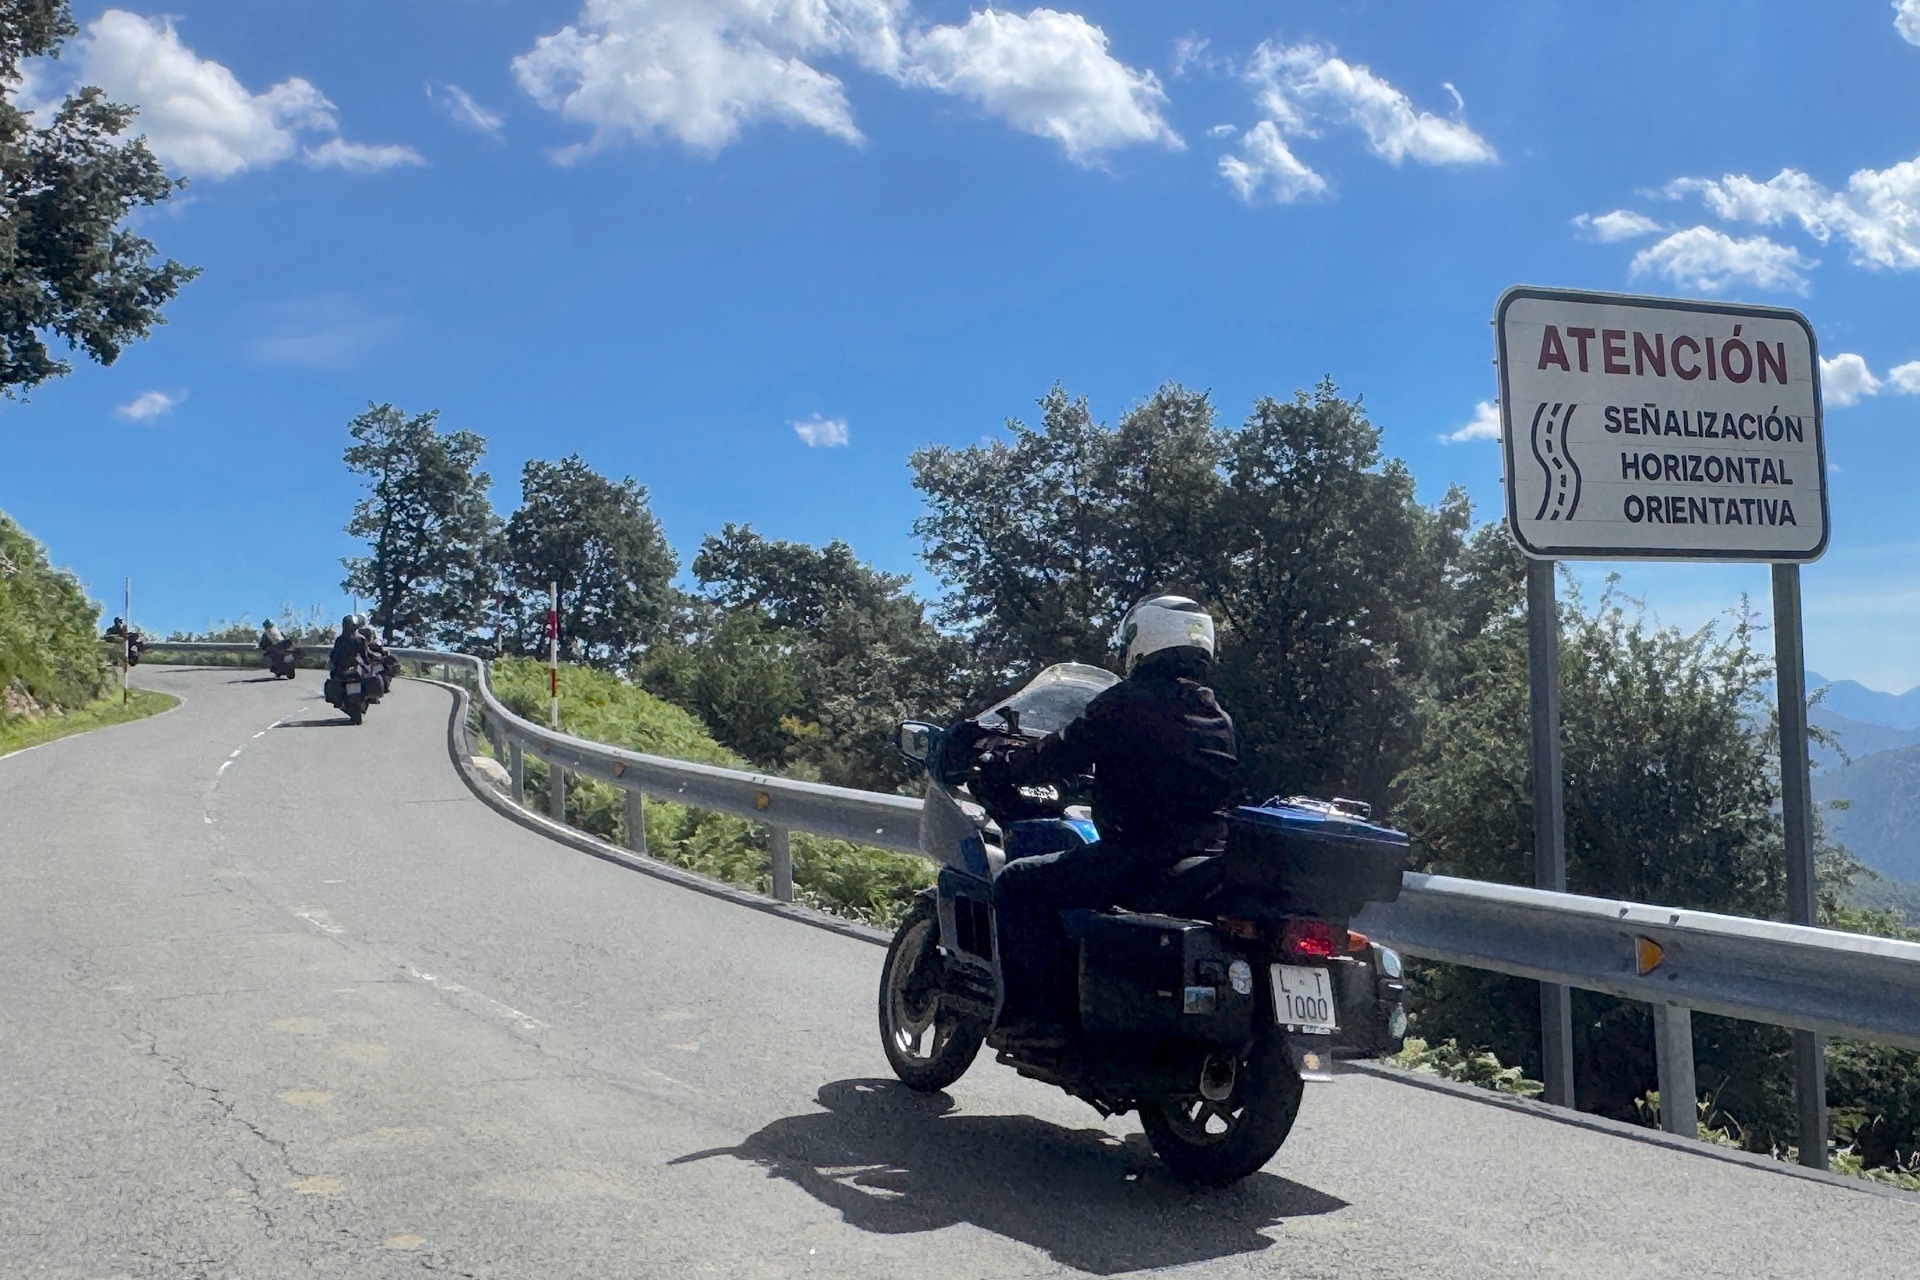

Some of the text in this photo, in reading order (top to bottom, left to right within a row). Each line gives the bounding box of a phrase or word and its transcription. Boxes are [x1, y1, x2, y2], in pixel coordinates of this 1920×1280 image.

[1537, 323, 1788, 385] ATENCIÓN
[1604, 402, 1804, 443] SEÑALIZACIÓN
[1621, 451, 1794, 485] HORIZONTAL
[1623, 494, 1798, 526] ORIENTATIVA
[1285, 994, 1328, 1021] 1000
